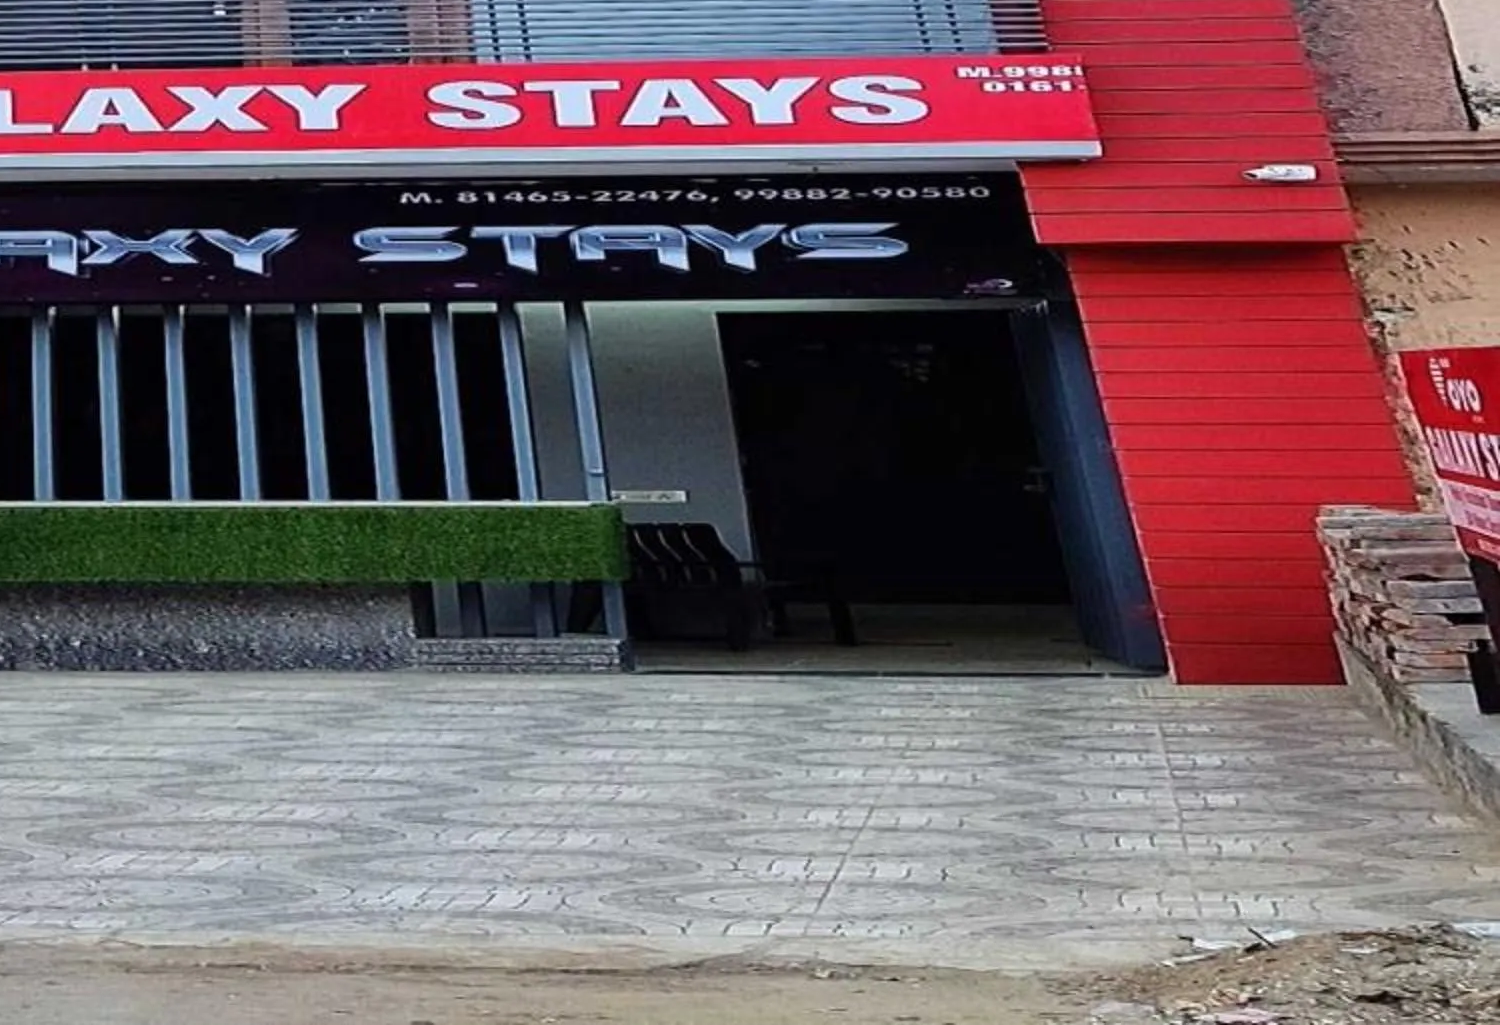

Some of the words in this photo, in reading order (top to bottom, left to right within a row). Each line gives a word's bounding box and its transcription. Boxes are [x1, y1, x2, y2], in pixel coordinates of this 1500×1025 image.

[426, 74, 930, 130] STAYS
[399, 191, 444, 205] M.
[733, 186, 991, 201] 99882-90580
[352, 220, 909, 273] STAYS
